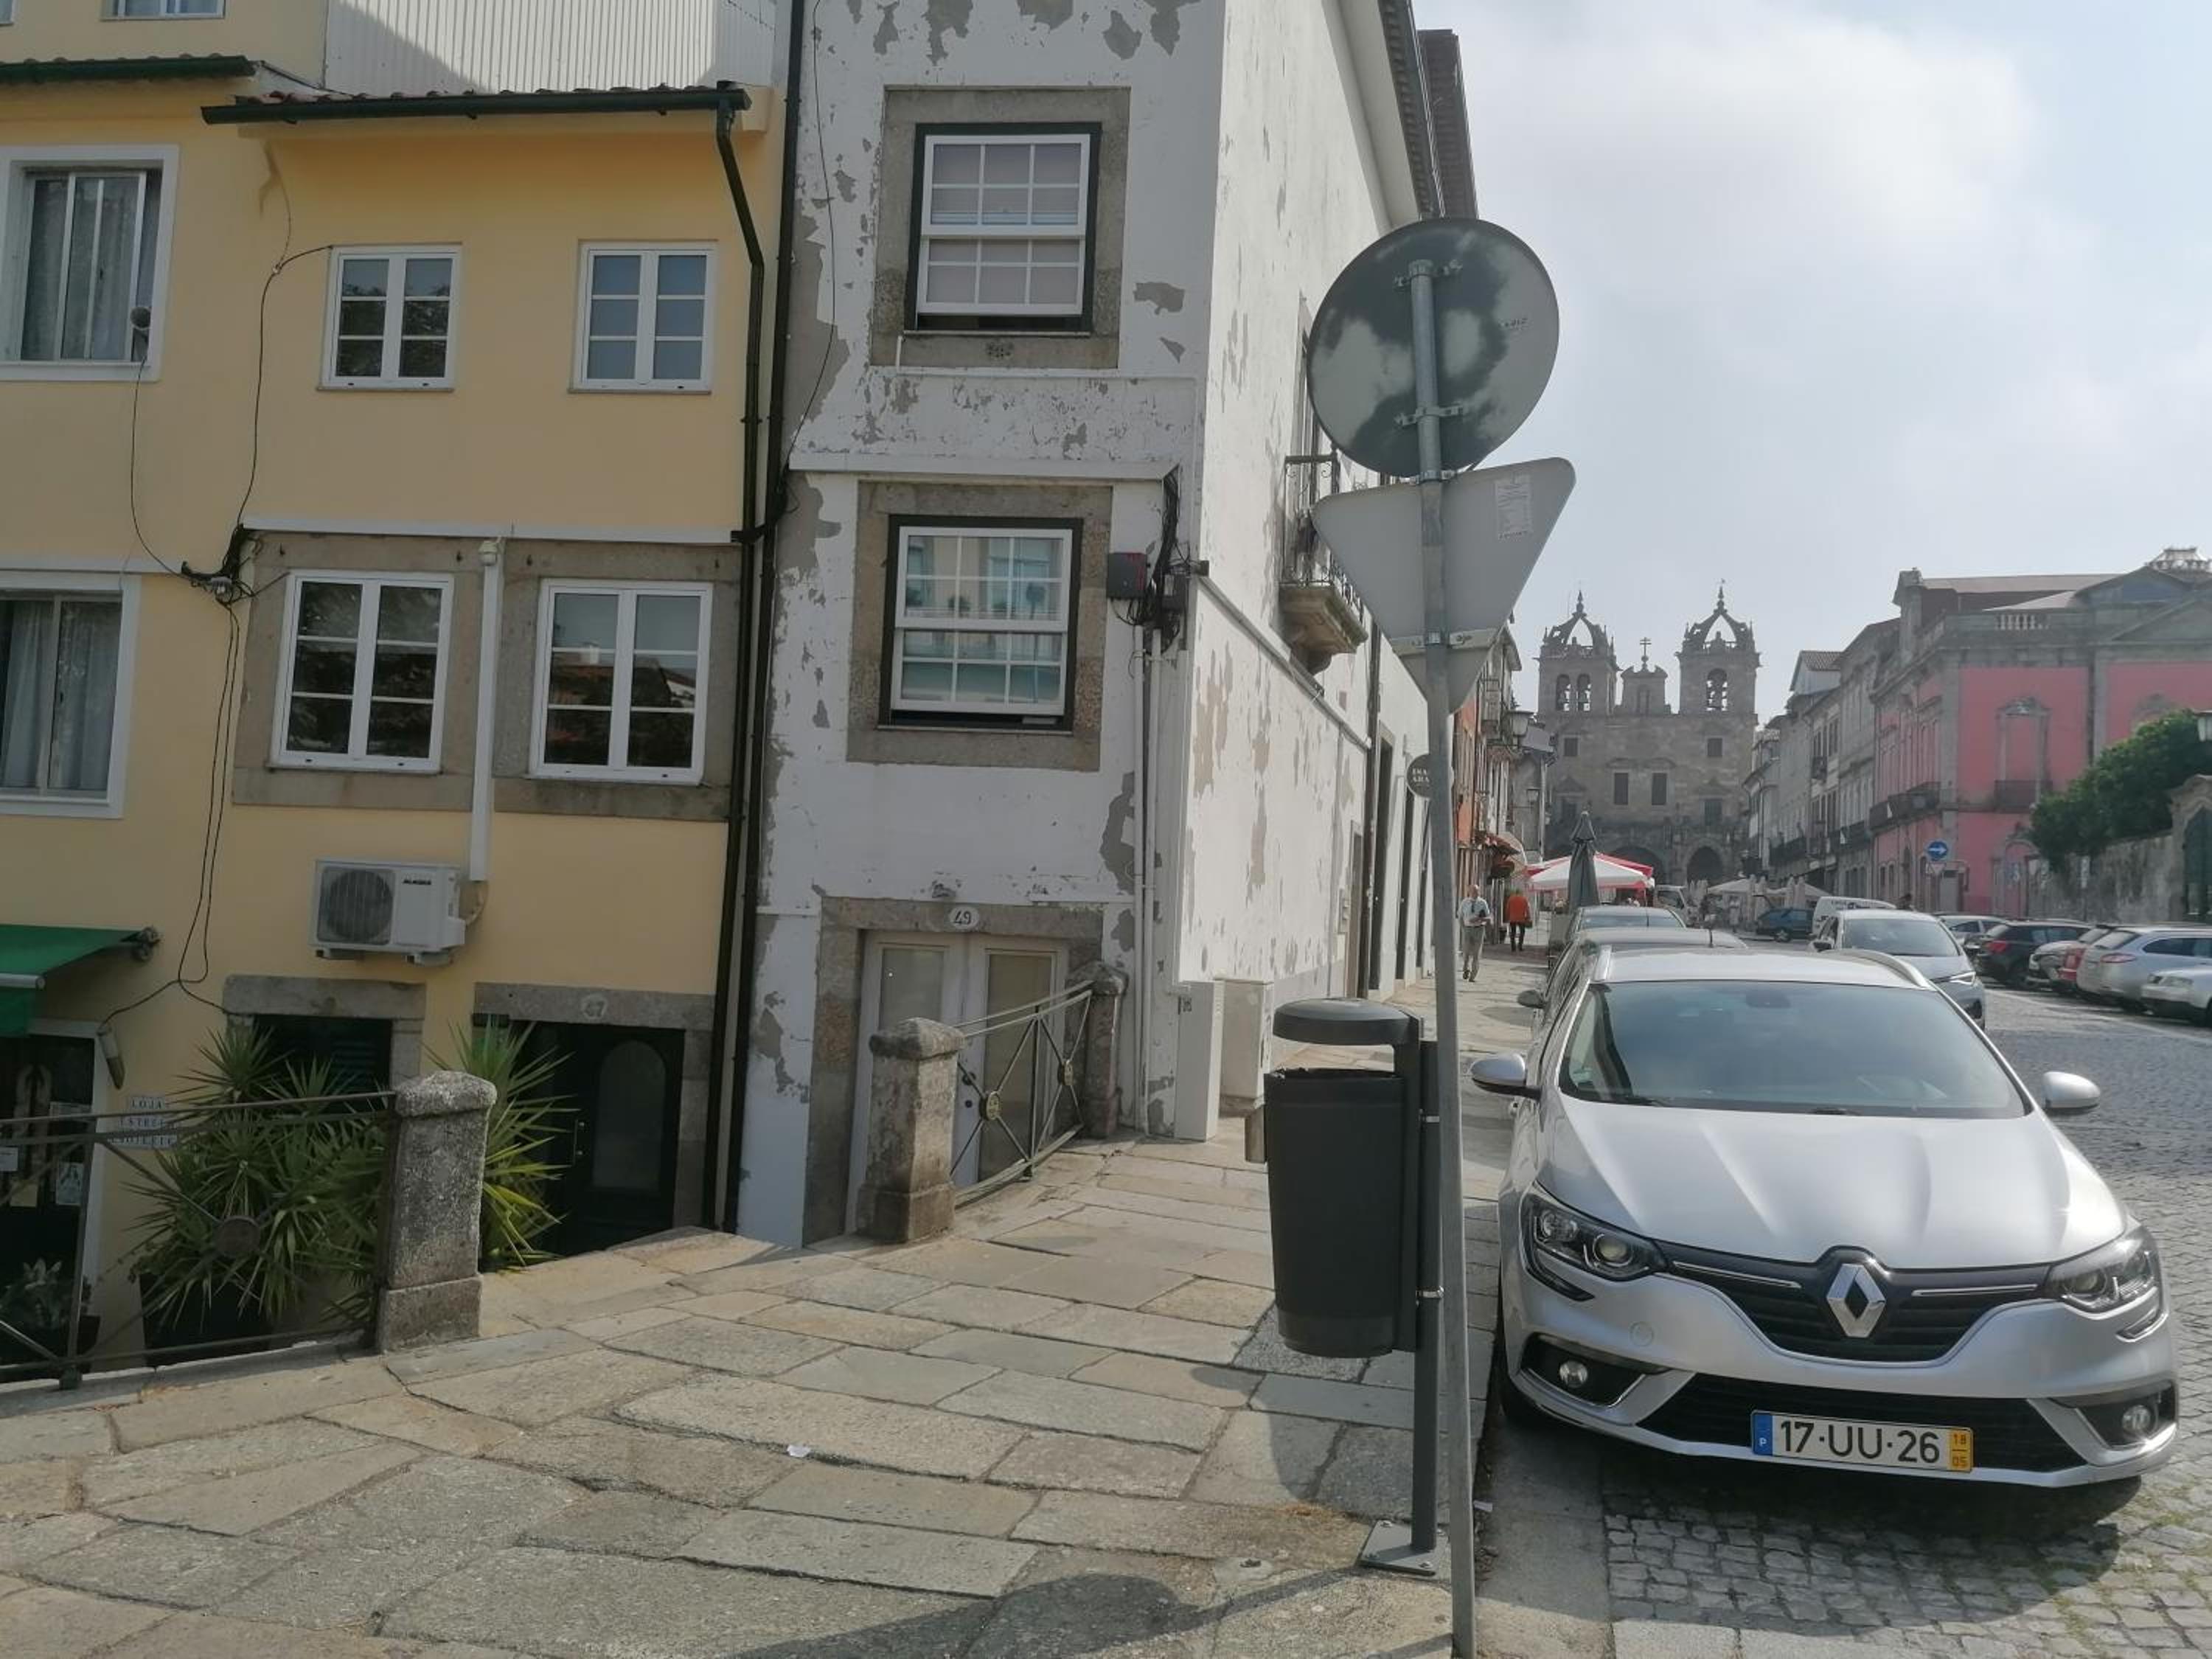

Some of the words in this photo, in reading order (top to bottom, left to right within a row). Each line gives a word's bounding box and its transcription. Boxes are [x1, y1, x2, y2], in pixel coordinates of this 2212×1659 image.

[954, 910, 972, 925] 49
[1759, 1438, 1767, 1447] P
[1953, 1433, 1966, 1445] 18
[1952, 1455, 1967, 1467] 05
